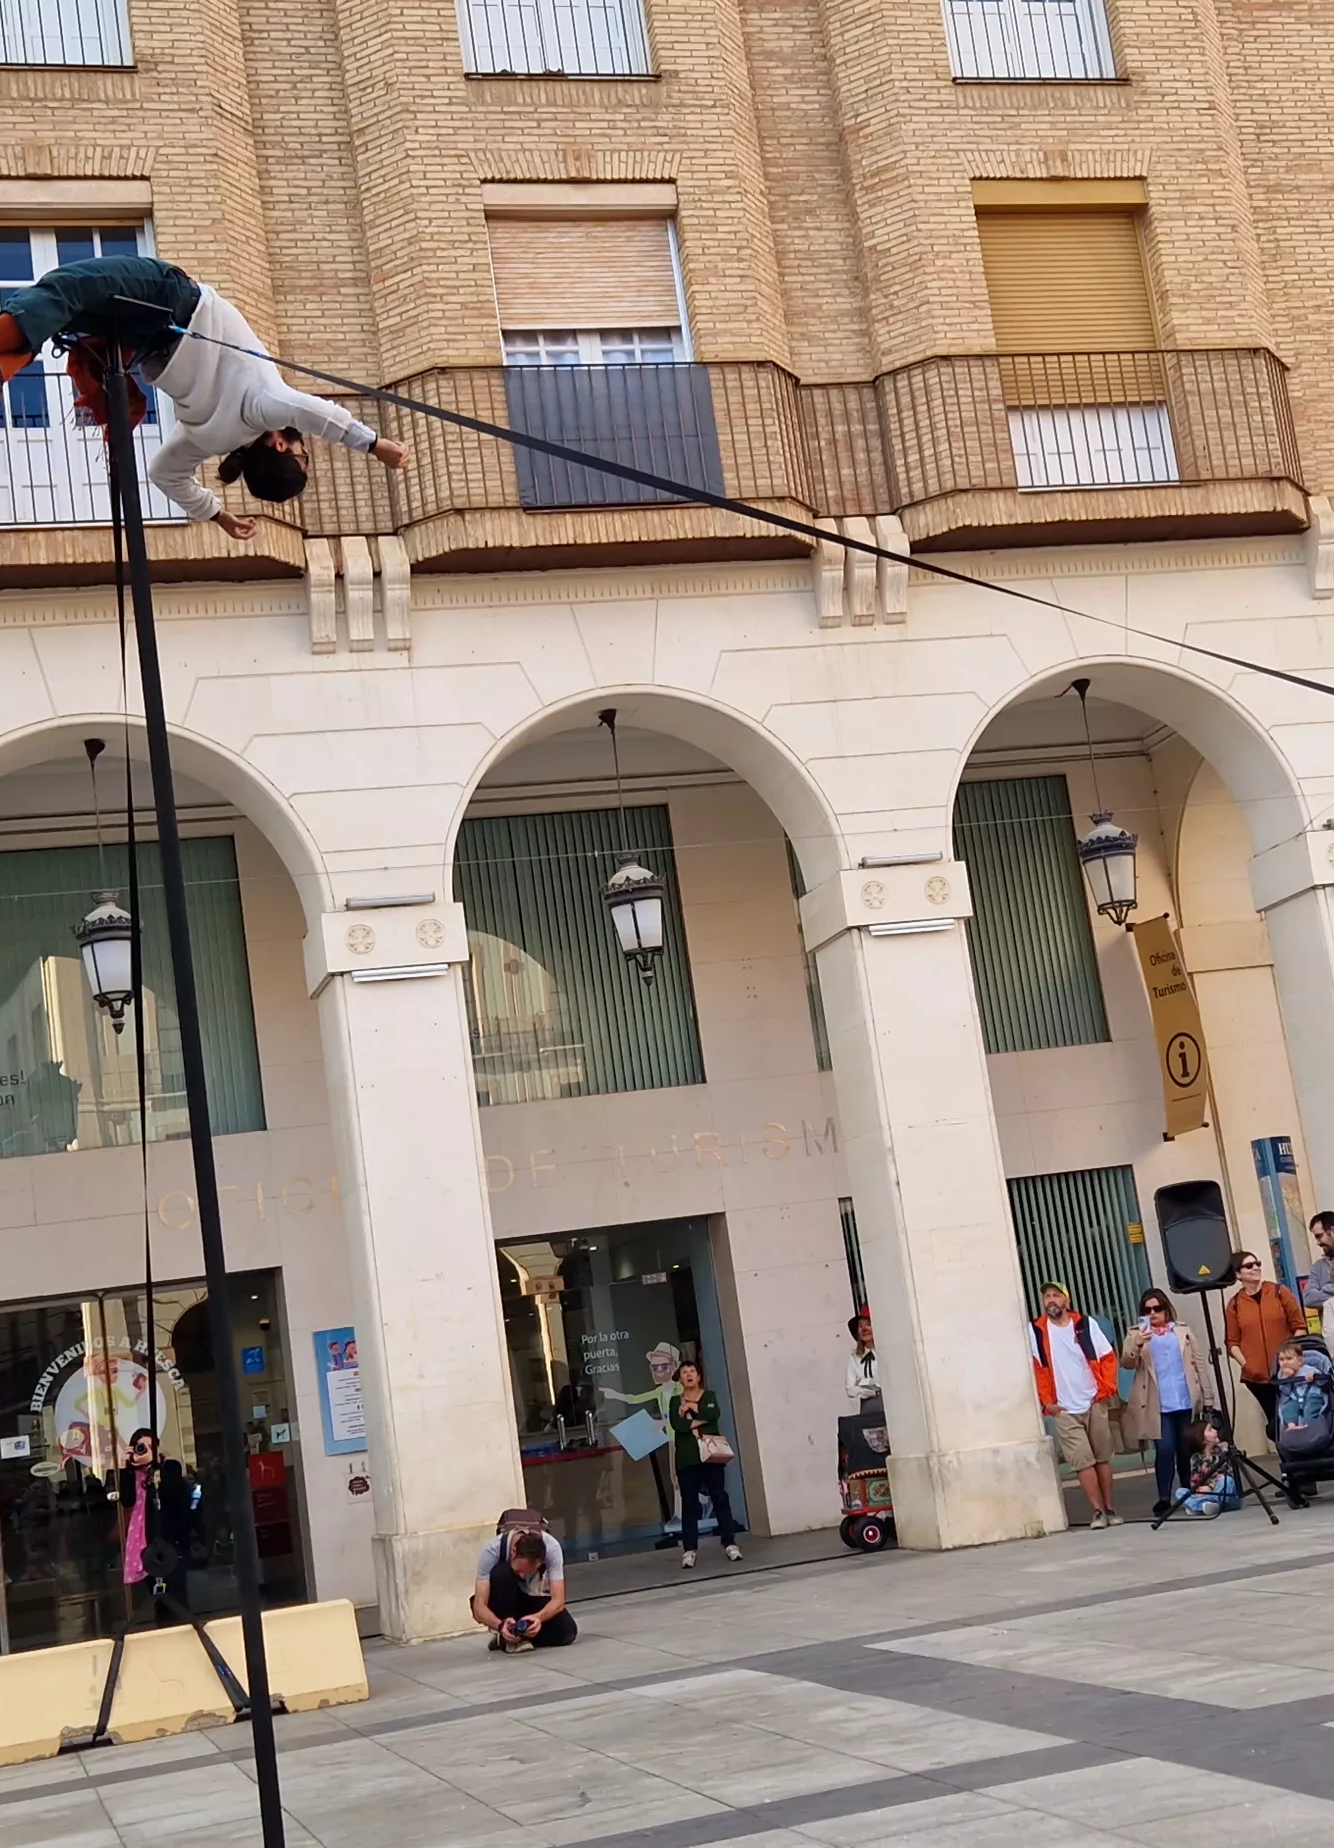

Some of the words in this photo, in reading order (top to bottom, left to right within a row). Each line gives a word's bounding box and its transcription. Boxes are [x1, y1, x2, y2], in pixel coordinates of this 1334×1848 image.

[1150, 951, 1176, 966] Oficina
[1171, 964, 1182, 977] de
[1152, 982, 1186, 999] Turismo
[581, 1334, 598, 1345] Por
[599, 1332, 608, 1342] la
[610, 1330, 629, 1341] otra
[119, 1336, 132, 1350] A
[135, 1339, 187, 1391] HESCA
[585, 1362, 620, 1375] Gracias
